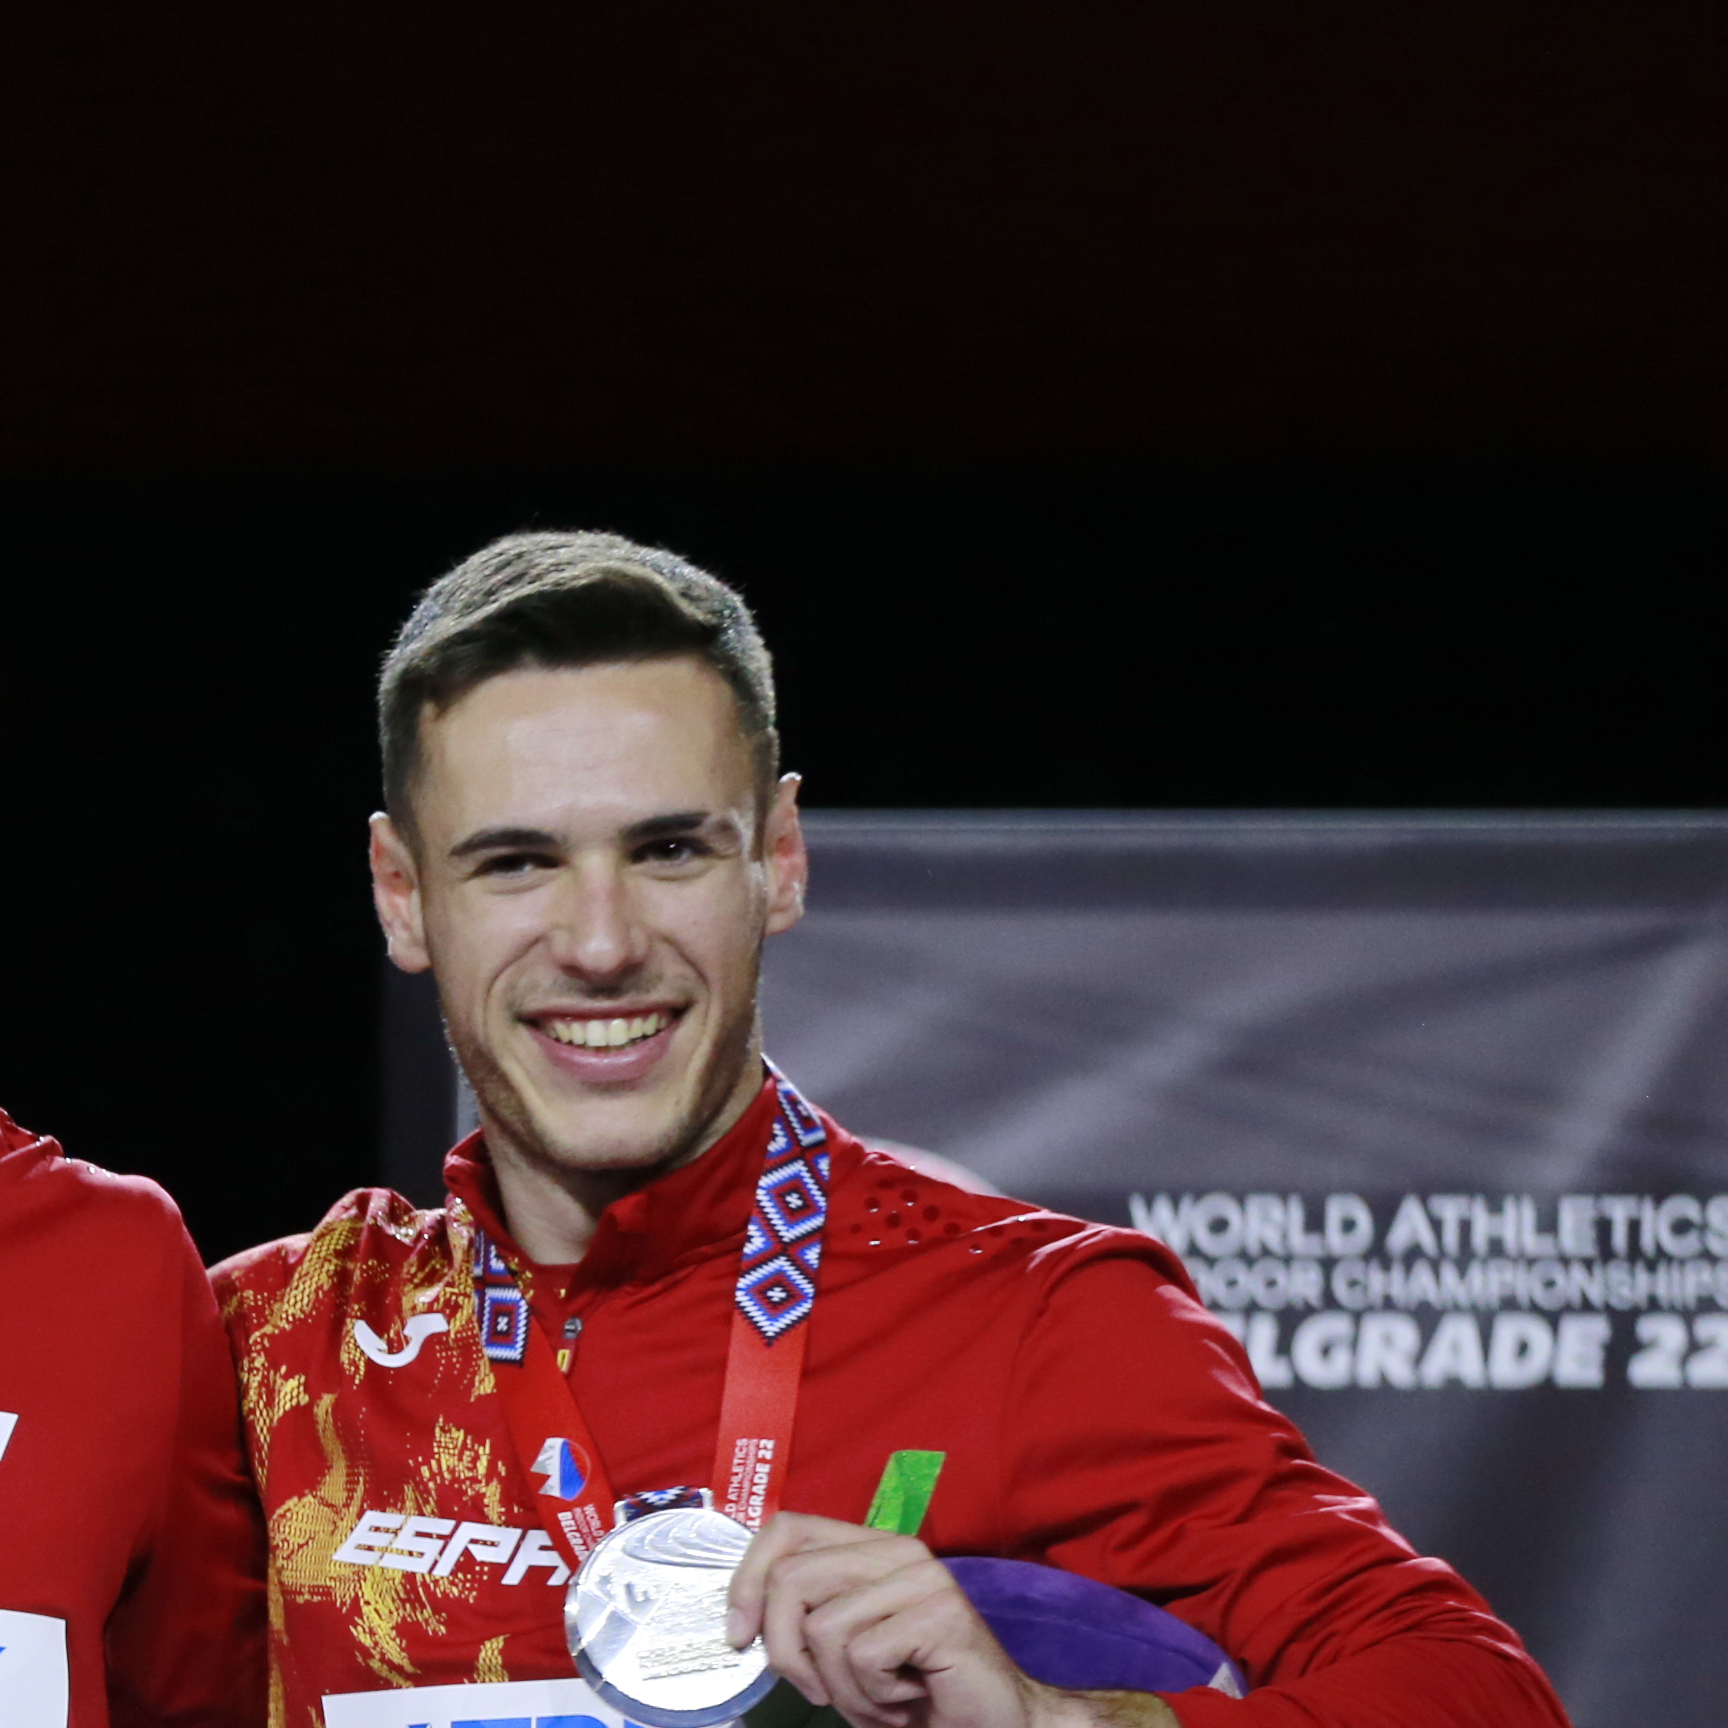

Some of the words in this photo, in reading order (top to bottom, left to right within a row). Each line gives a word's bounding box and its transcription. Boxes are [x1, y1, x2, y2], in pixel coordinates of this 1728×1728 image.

[1129, 1192, 1374, 1258] WORLD
[1386, 1190, 1728, 1259] ATHLETICS
[1190, 1258, 1324, 1311] OOR
[1236, 1311, 1612, 1391] LGRADE
[758, 1438, 775, 1460] 22
[746, 1463, 771, 1532] LGRADE
[332, 1509, 572, 1587] ESPA
[557, 1511, 589, 1561] BELGRAD
